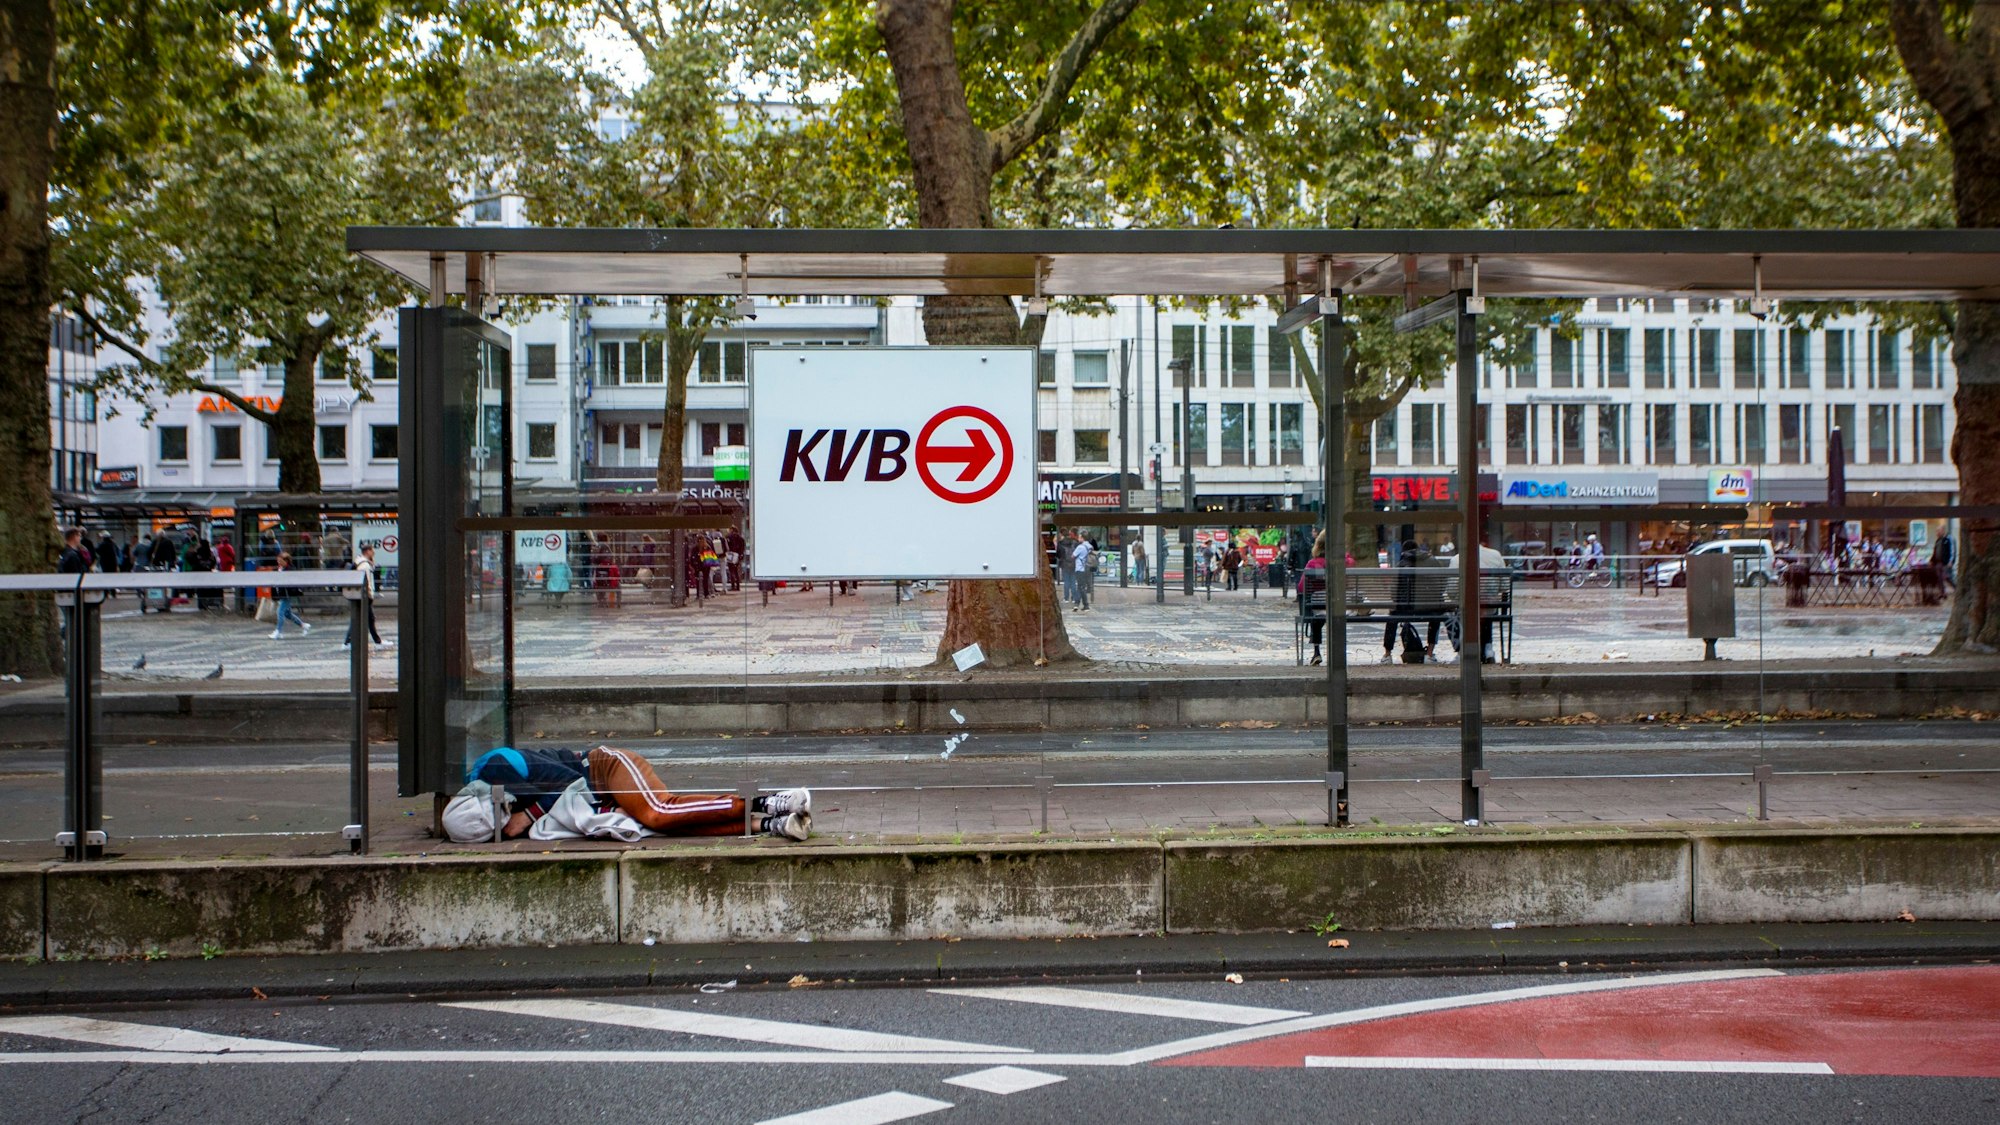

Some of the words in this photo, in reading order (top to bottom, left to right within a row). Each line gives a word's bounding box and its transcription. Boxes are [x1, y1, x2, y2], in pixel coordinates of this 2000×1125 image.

[779, 429, 911, 482] KVB
[1372, 477, 1450, 501] REWE
[1507, 480, 1568, 498] AllDent
[1571, 485, 1657, 498] ZAHNZENTRUM
[1721, 473, 1744, 488] dm
[1038, 481, 1075, 501] ART
[1062, 493, 1120, 505] Neumarkt
[521, 537, 544, 547] KVB
